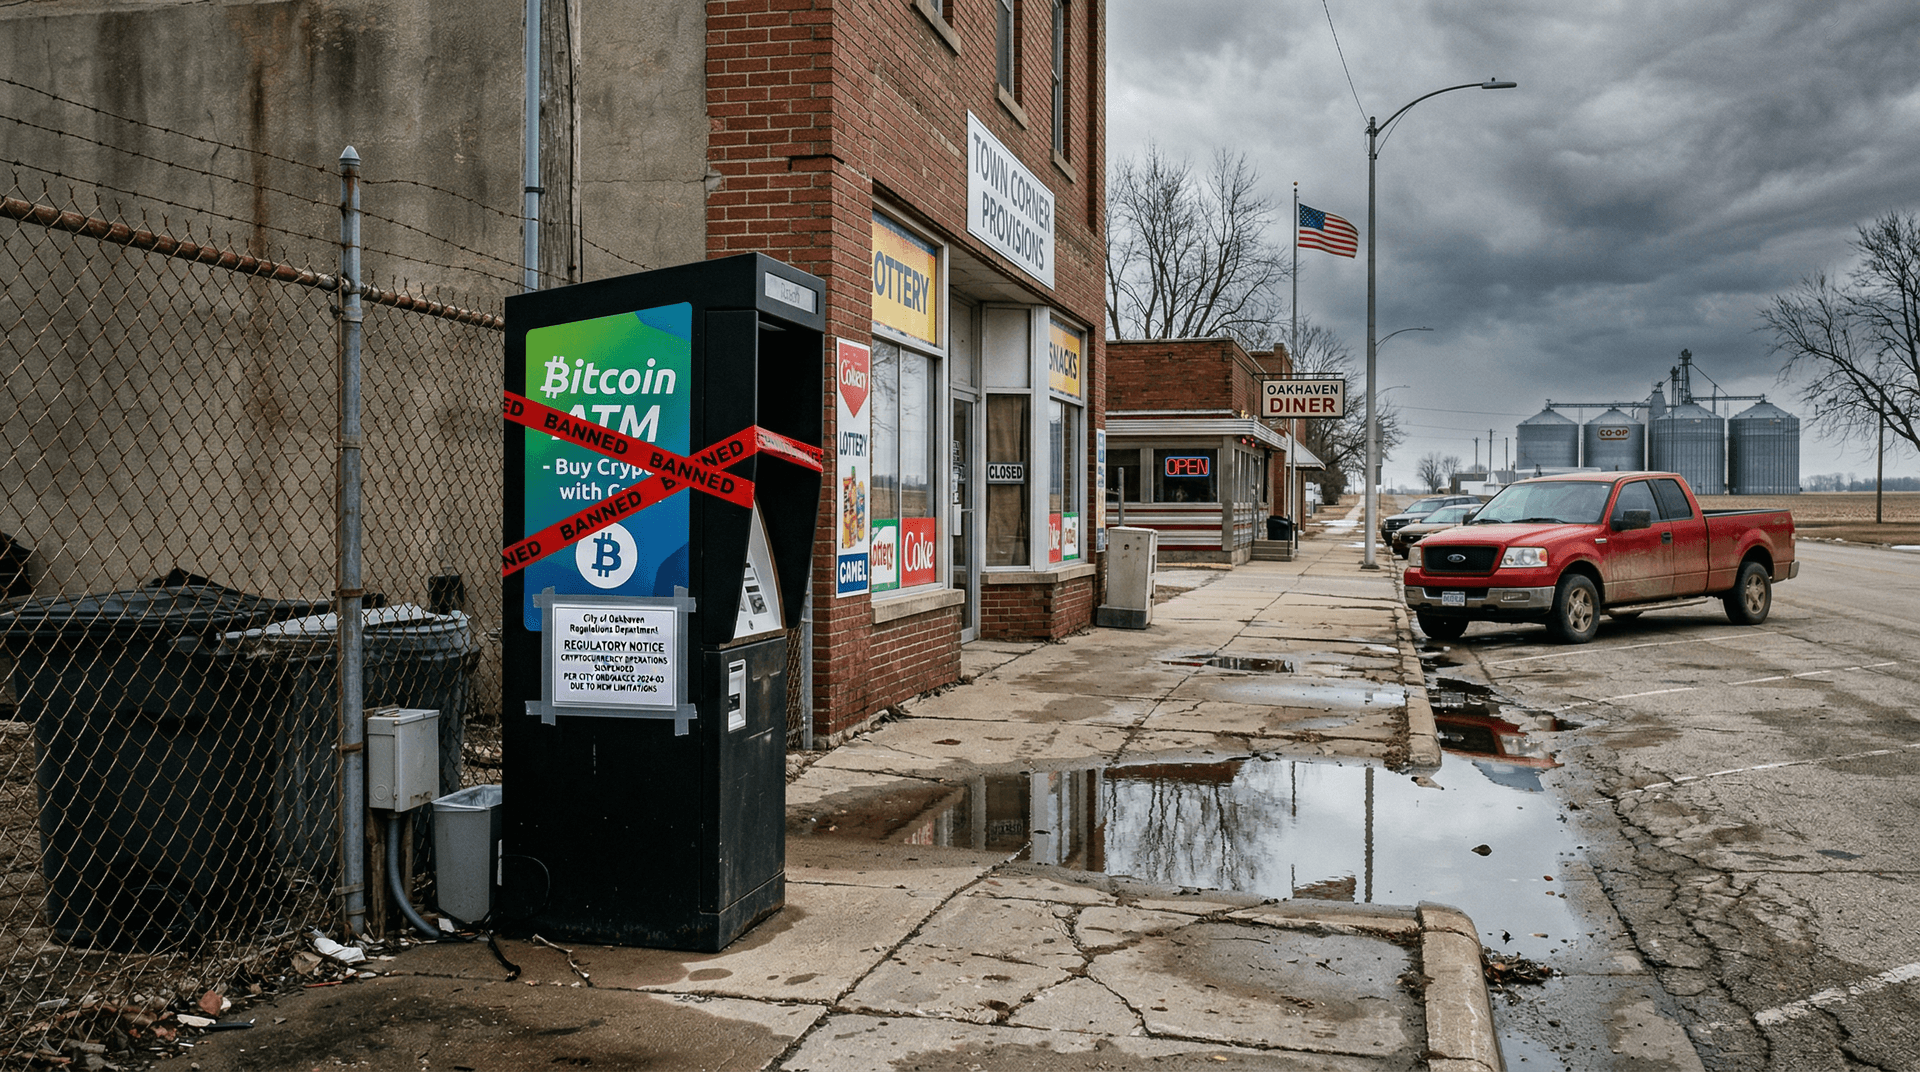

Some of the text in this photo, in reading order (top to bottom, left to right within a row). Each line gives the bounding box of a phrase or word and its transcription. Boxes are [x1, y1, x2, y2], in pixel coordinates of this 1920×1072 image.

[973, 131, 1050, 233] TOWN CORNER
[983, 191, 1044, 271] PROVISIONS
[1049, 341, 1077, 380] SNACKS
[1267, 384, 1338, 395] OAKHAVEN
[1270, 398, 1336, 413] DINER
[544, 412, 628, 455] BANNED
[649, 451, 735, 494] BANNED
[840, 431, 868, 457] LOTTERY
[556, 458, 592, 479] Buy
[989, 465, 1022, 479] CLOSED
[1166, 458, 1208, 475] OPEN
[559, 482, 602, 500] with
[560, 491, 642, 541] BANNED
[904, 531, 934, 572] Coke
[840, 560, 867, 584] CAMEL
[564, 640, 665, 652] REGULATORY NOTICE
[563, 672, 578, 680] PER
[570, 682, 585, 690] DUE
[586, 683, 596, 691] TO
